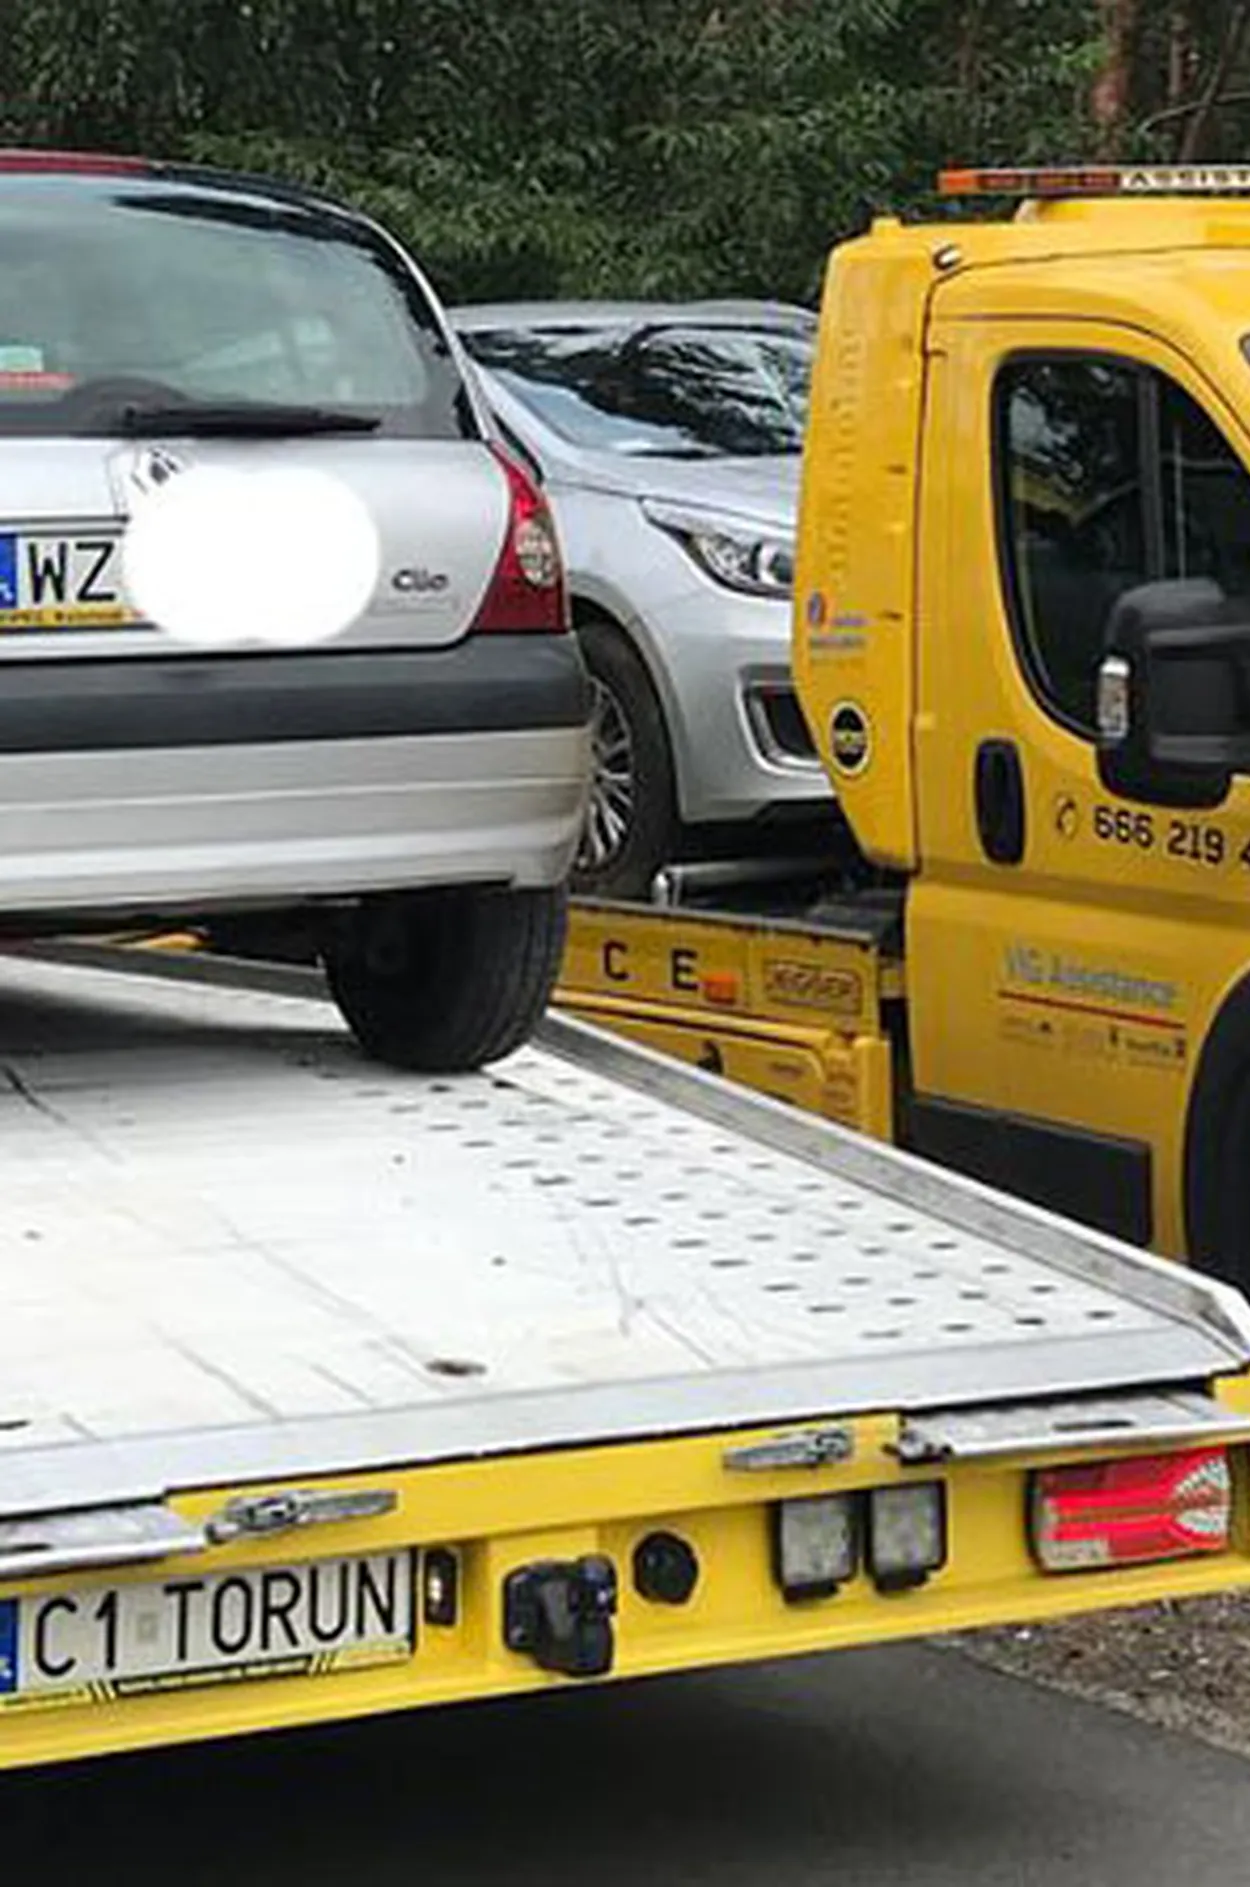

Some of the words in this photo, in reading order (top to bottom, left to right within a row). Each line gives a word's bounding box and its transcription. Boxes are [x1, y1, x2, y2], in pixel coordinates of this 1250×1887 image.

[28, 541, 116, 604] WZ
[1094, 806, 1152, 849] 666
[1167, 820, 1225, 866] 219
[34, 1590, 118, 1677] C1
[163, 1557, 396, 1661] TORUN
